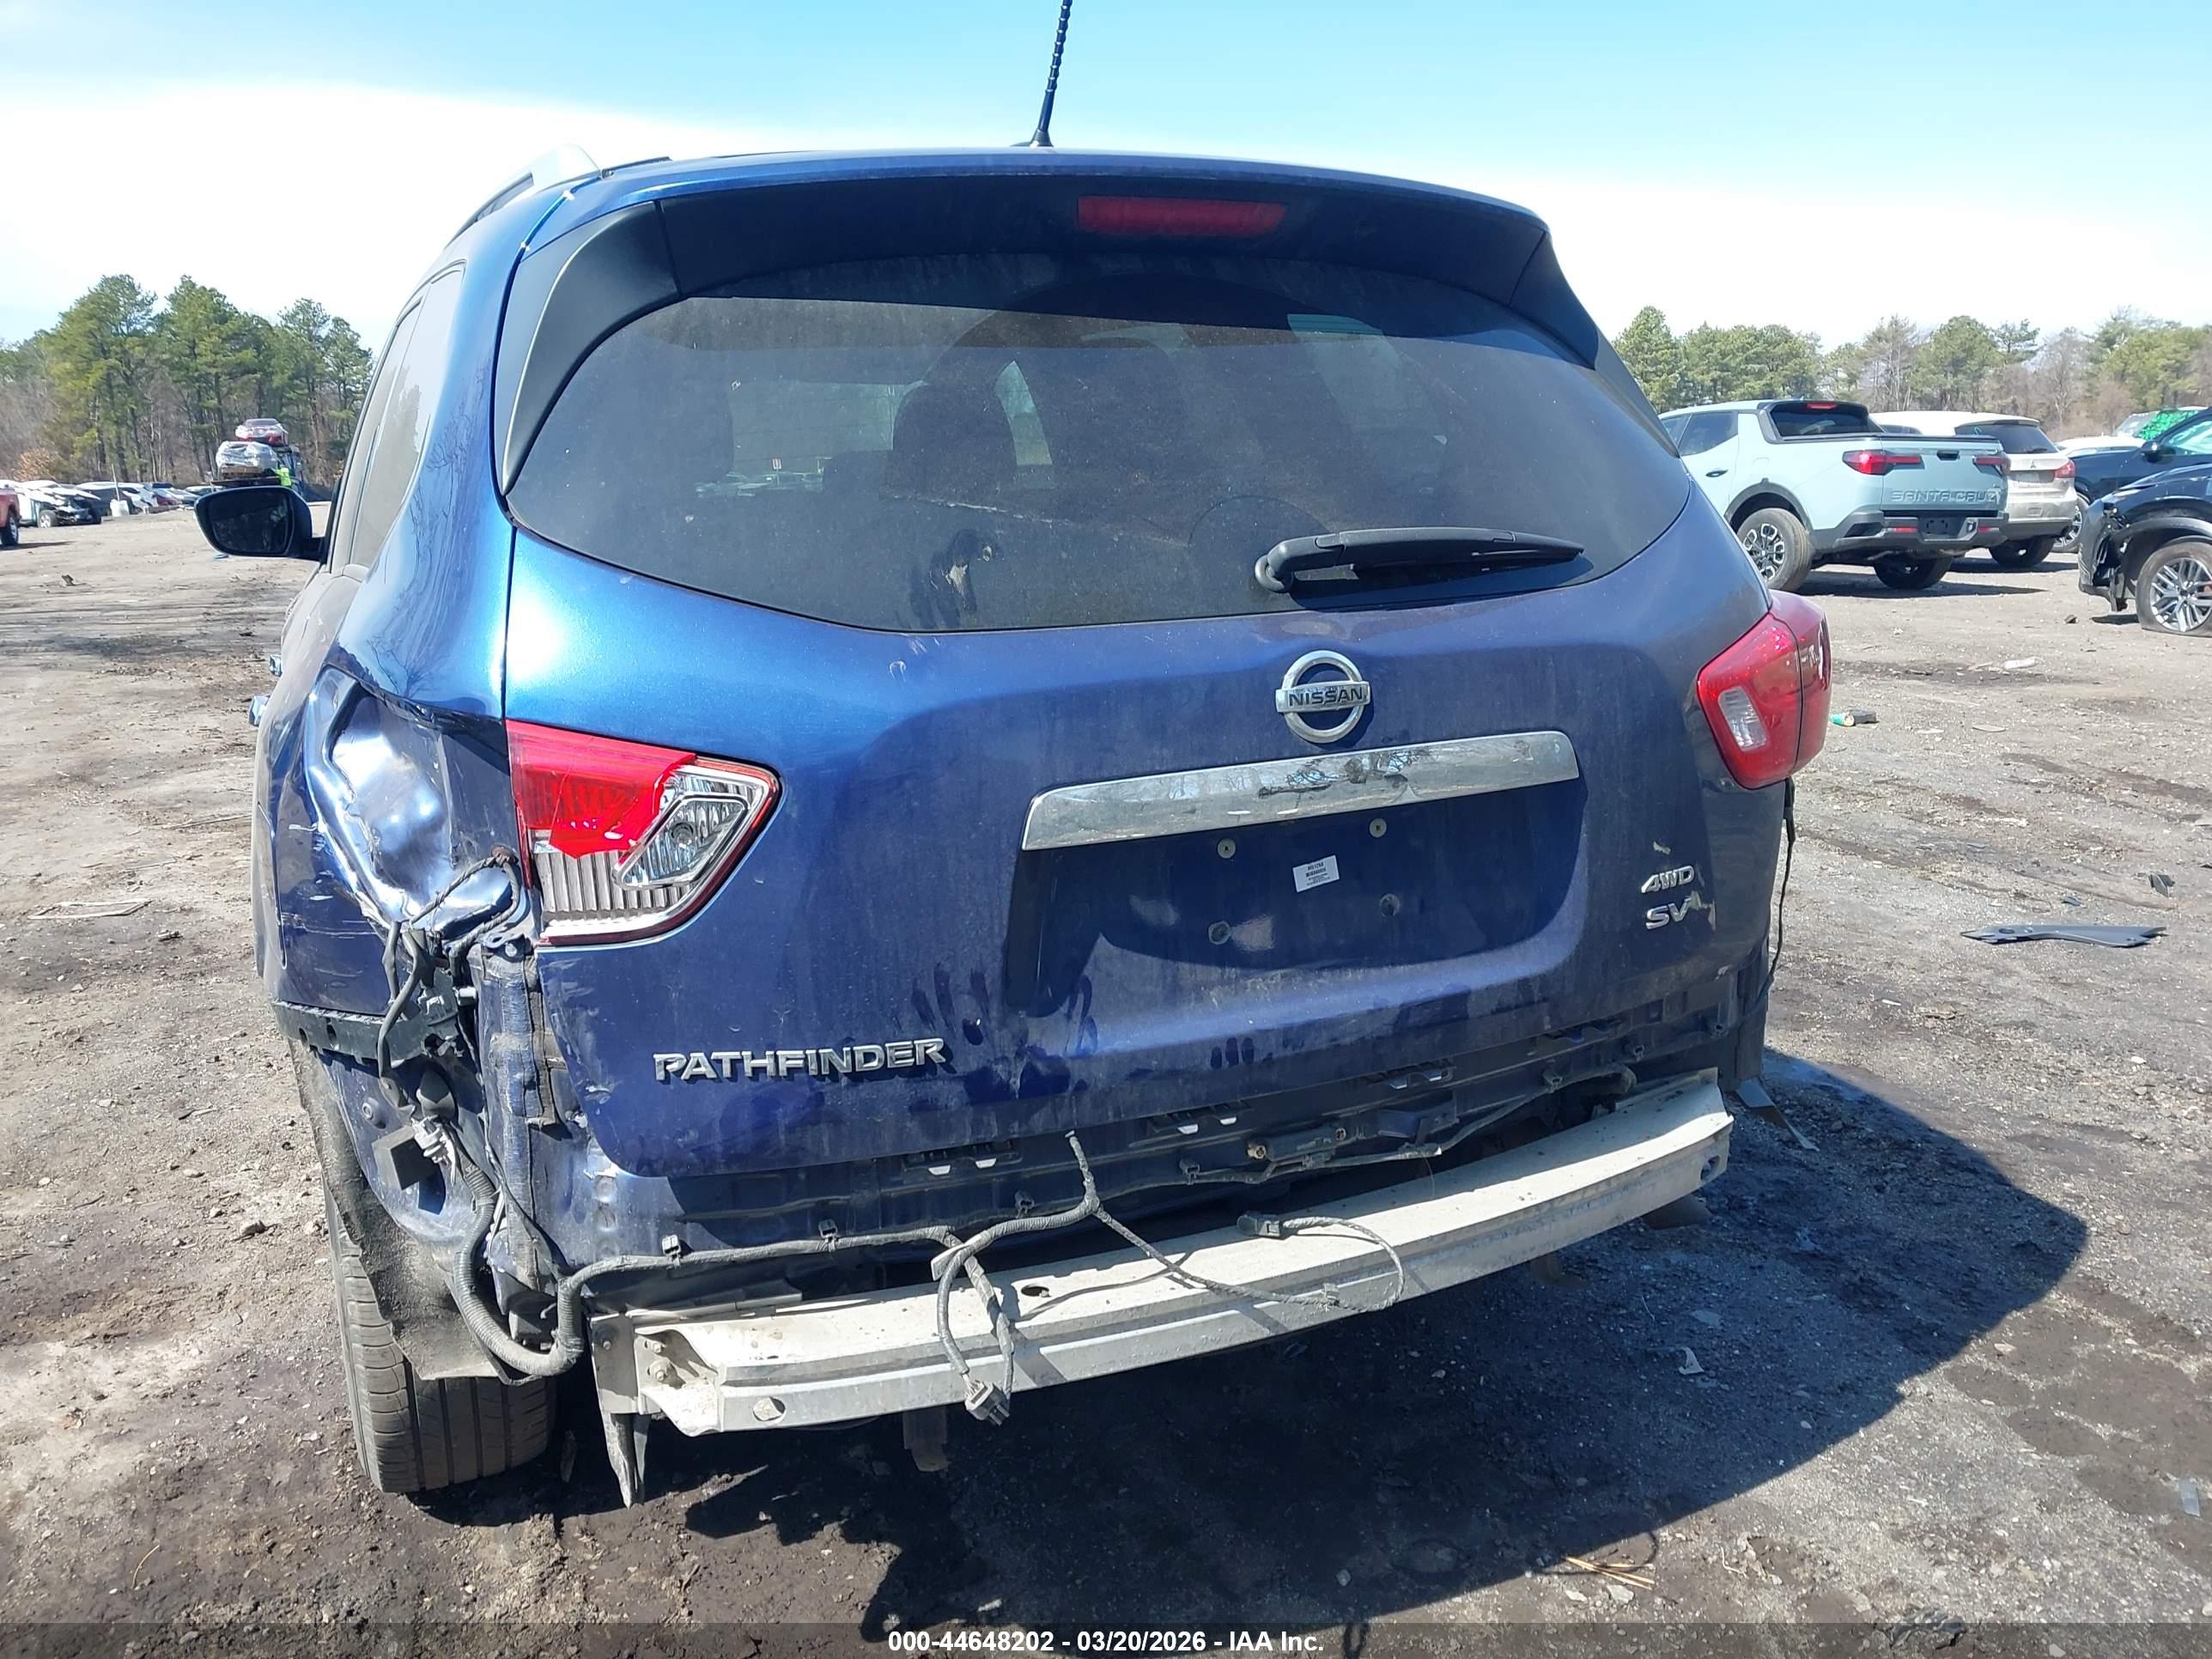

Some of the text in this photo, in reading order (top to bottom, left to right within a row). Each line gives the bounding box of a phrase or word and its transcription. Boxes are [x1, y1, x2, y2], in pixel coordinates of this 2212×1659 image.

[1891, 489, 1951, 502] SANTA
[1289, 686, 1363, 707] NISSAN
[1641, 865, 1694, 893] 4WD
[1646, 896, 1692, 930] SV
[653, 1037, 946, 1081] PATHFINDER
